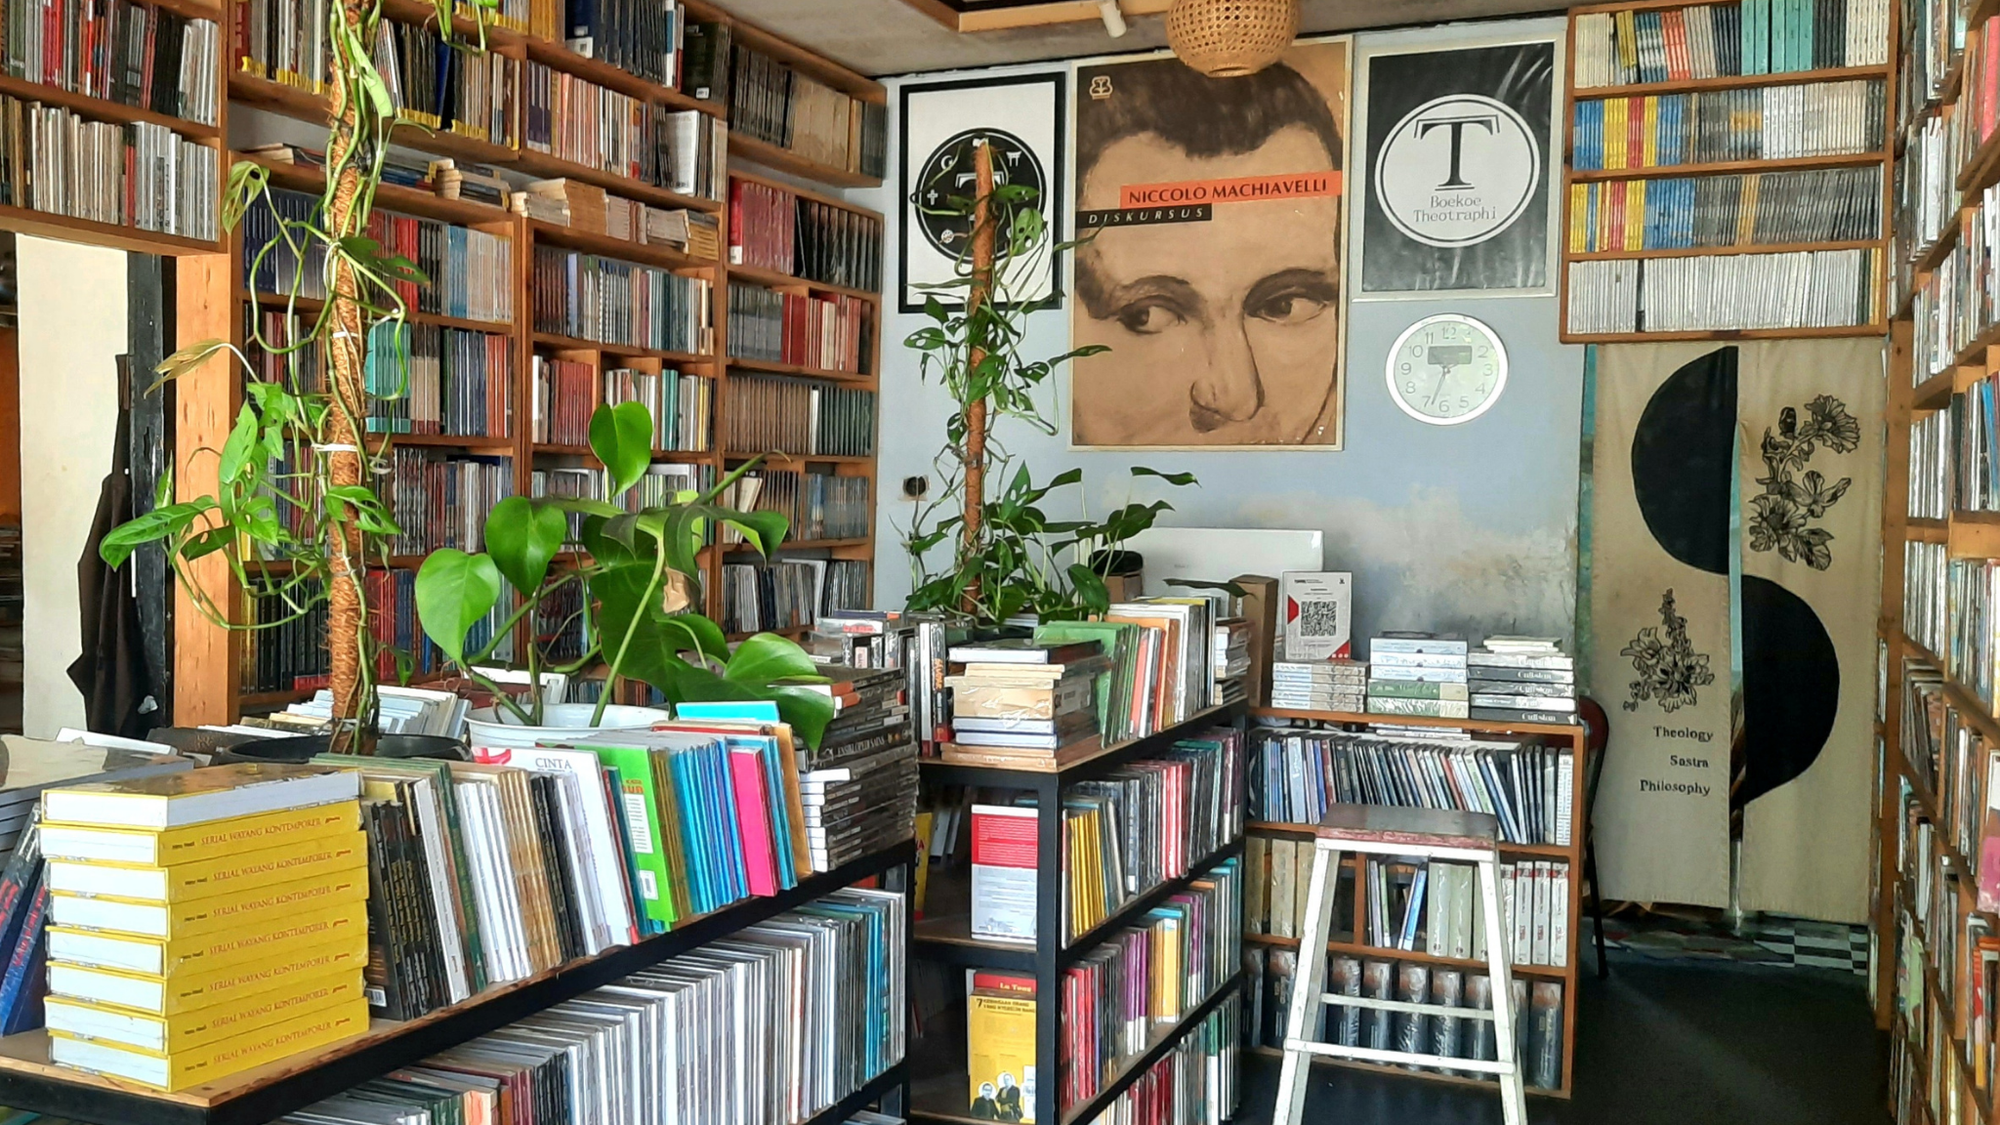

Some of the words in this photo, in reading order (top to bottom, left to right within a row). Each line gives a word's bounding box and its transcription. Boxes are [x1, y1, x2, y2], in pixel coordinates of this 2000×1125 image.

[1128, 186, 1207, 204] NICCOLO
[1211, 178, 1328, 199] MACHIAVELLI
[1429, 194, 1482, 209] Boekoe
[1087, 207, 1204, 225] DISKURSUS
[1413, 206, 1497, 223] Theotraphi
[1425, 331, 1434, 345] 11
[1409, 344, 1424, 358] 10
[1477, 345, 1489, 359] 2
[1400, 362, 1412, 375] 9
[1482, 363, 1494, 377] 3
[1405, 381, 1416, 394] 8
[1475, 382, 1486, 395] 4
[1422, 395, 1432, 408] 7
[1438, 399, 1450, 413] 6
[1458, 395, 1470, 409] 5
[1653, 725, 1714, 743] Theology
[535, 757, 573, 769] CINTA
[1670, 754, 1709, 768] Sastra
[1640, 777, 1711, 797] Philosophy
[201, 830, 227, 845] SERIAL
[229, 827, 263, 842] WAYANG
[213, 866, 239, 882] SERIAL
[241, 862, 274, 877] WAYANG
[213, 901, 239, 917] SERIAL
[241, 897, 274, 912] WAYANG
[209, 940, 236, 955] SERIAL
[238, 933, 271, 949] WAYANG
[209, 979, 235, 993] SERIAL
[238, 969, 271, 985] WAYANG
[212, 1014, 237, 1029] SERIAL
[239, 1005, 272, 1020] WAYANG
[213, 1051, 238, 1066] SERIAL
[241, 1040, 274, 1056] WAYANG
